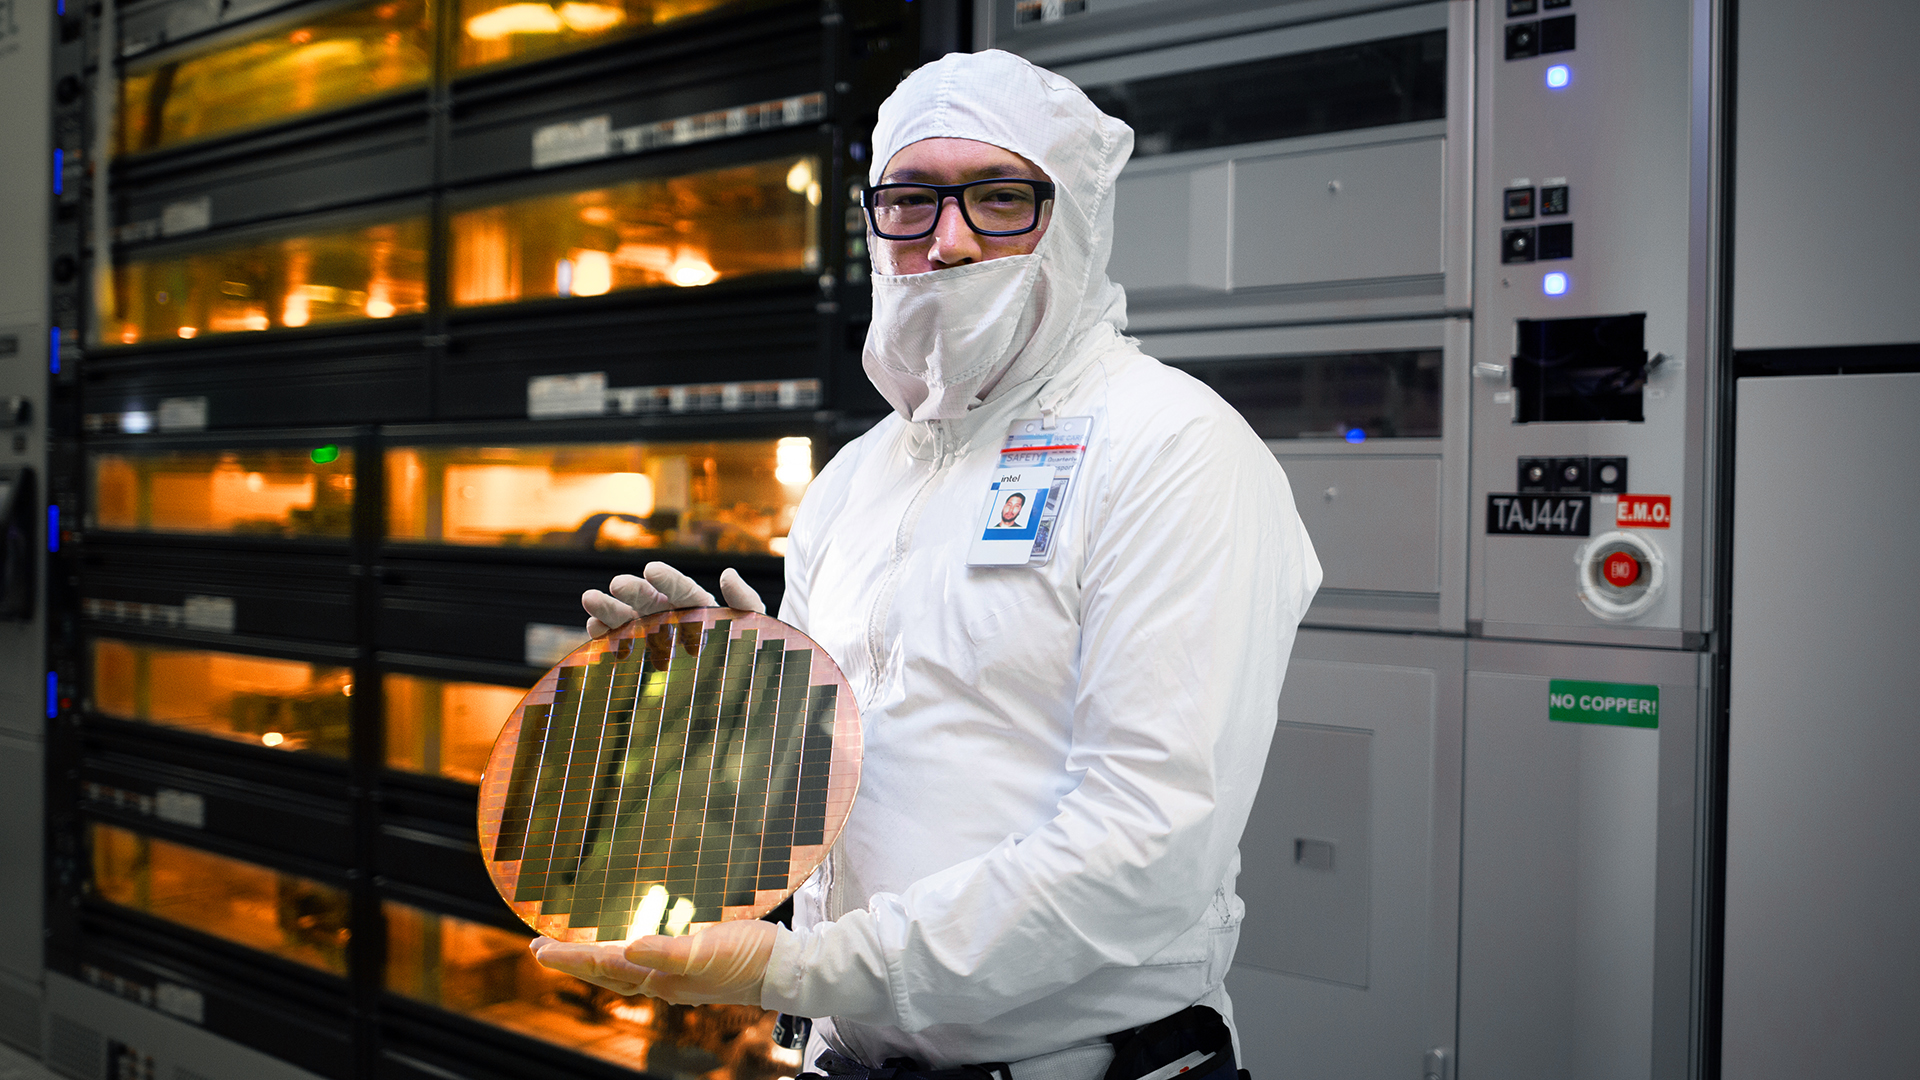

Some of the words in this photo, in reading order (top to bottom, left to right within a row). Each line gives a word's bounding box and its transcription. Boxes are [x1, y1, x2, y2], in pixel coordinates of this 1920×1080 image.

[1006, 453, 1042, 462] SAFETY
[1047, 456, 1077, 464] Quarterly
[1000, 474, 1021, 482] intel
[1492, 498, 1584, 532] TAJ447
[1617, 501, 1670, 523] E.M.O.
[1611, 561, 1630, 578] EMO
[1550, 693, 1576, 709] NO
[1579, 695, 1656, 715] COPPER!
